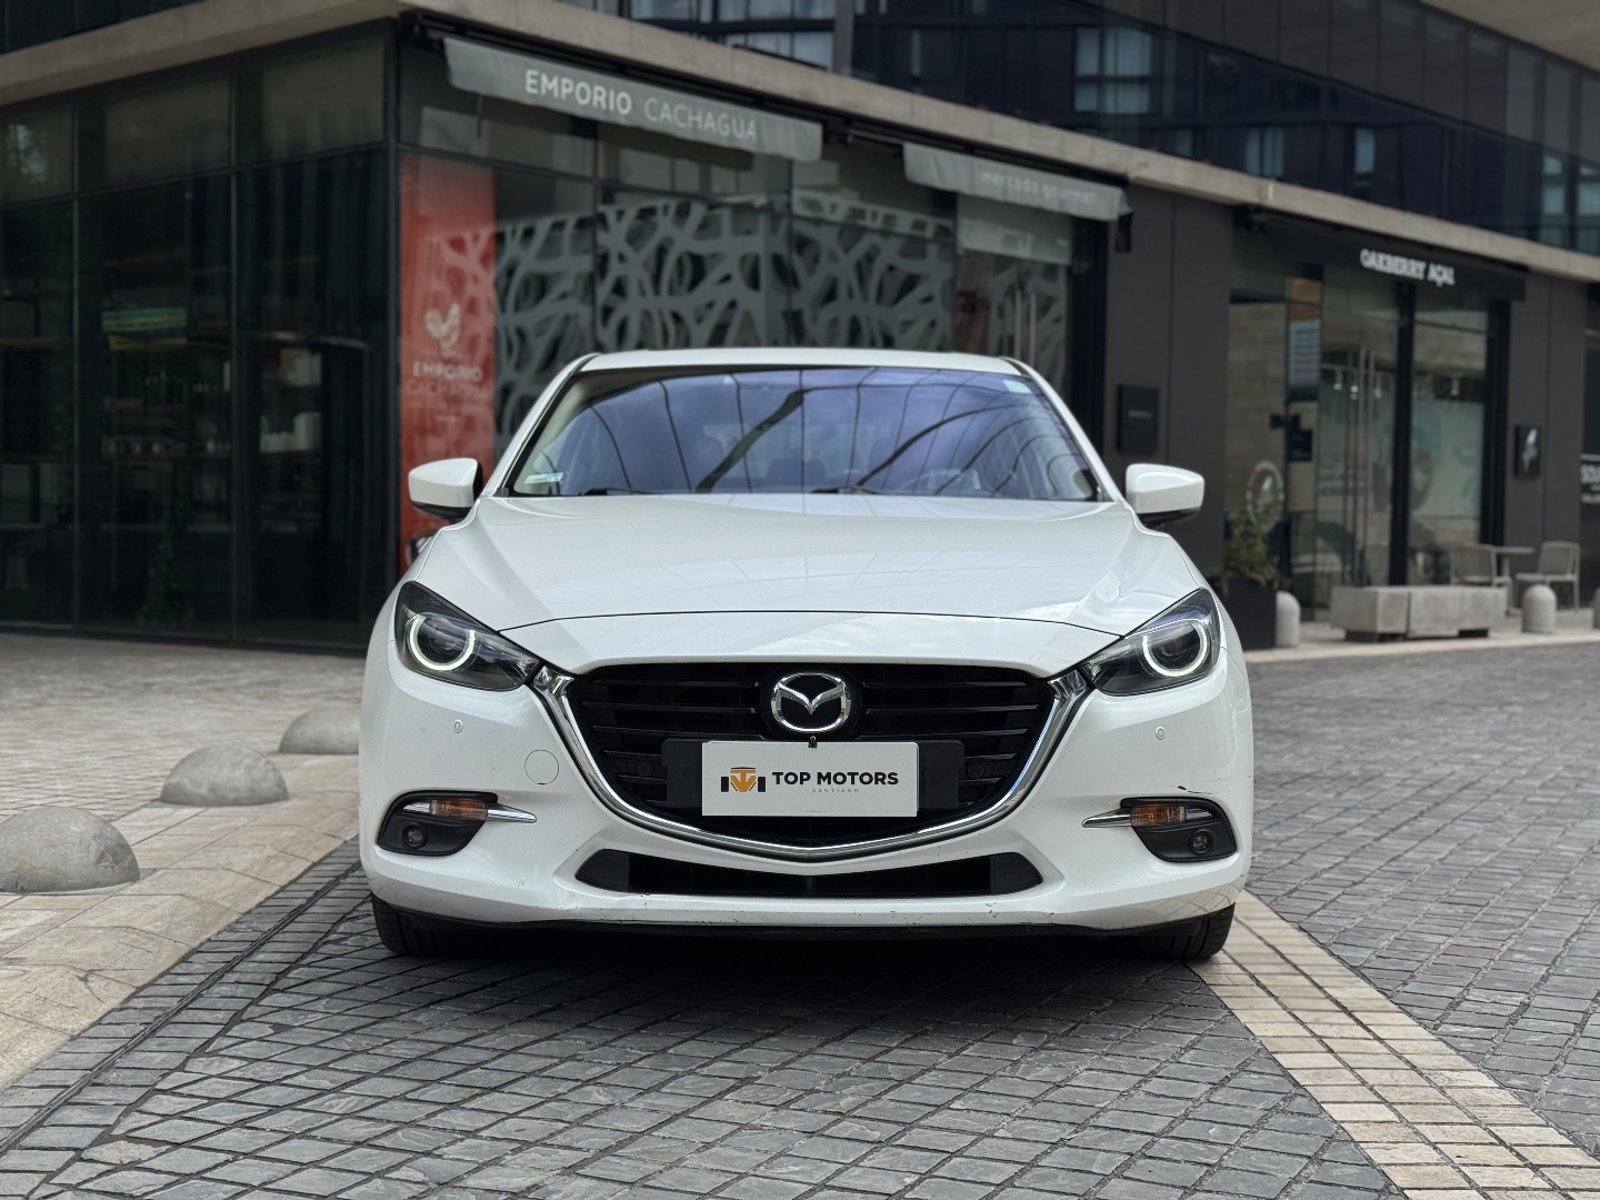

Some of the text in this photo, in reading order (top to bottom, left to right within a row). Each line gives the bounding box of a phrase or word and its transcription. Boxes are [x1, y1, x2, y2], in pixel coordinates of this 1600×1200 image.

[525, 69, 758, 143] EMPORIO CACHAGUA
[412, 361, 484, 382] EMPORIO
[771, 771, 899, 786] TOP MOTORS
